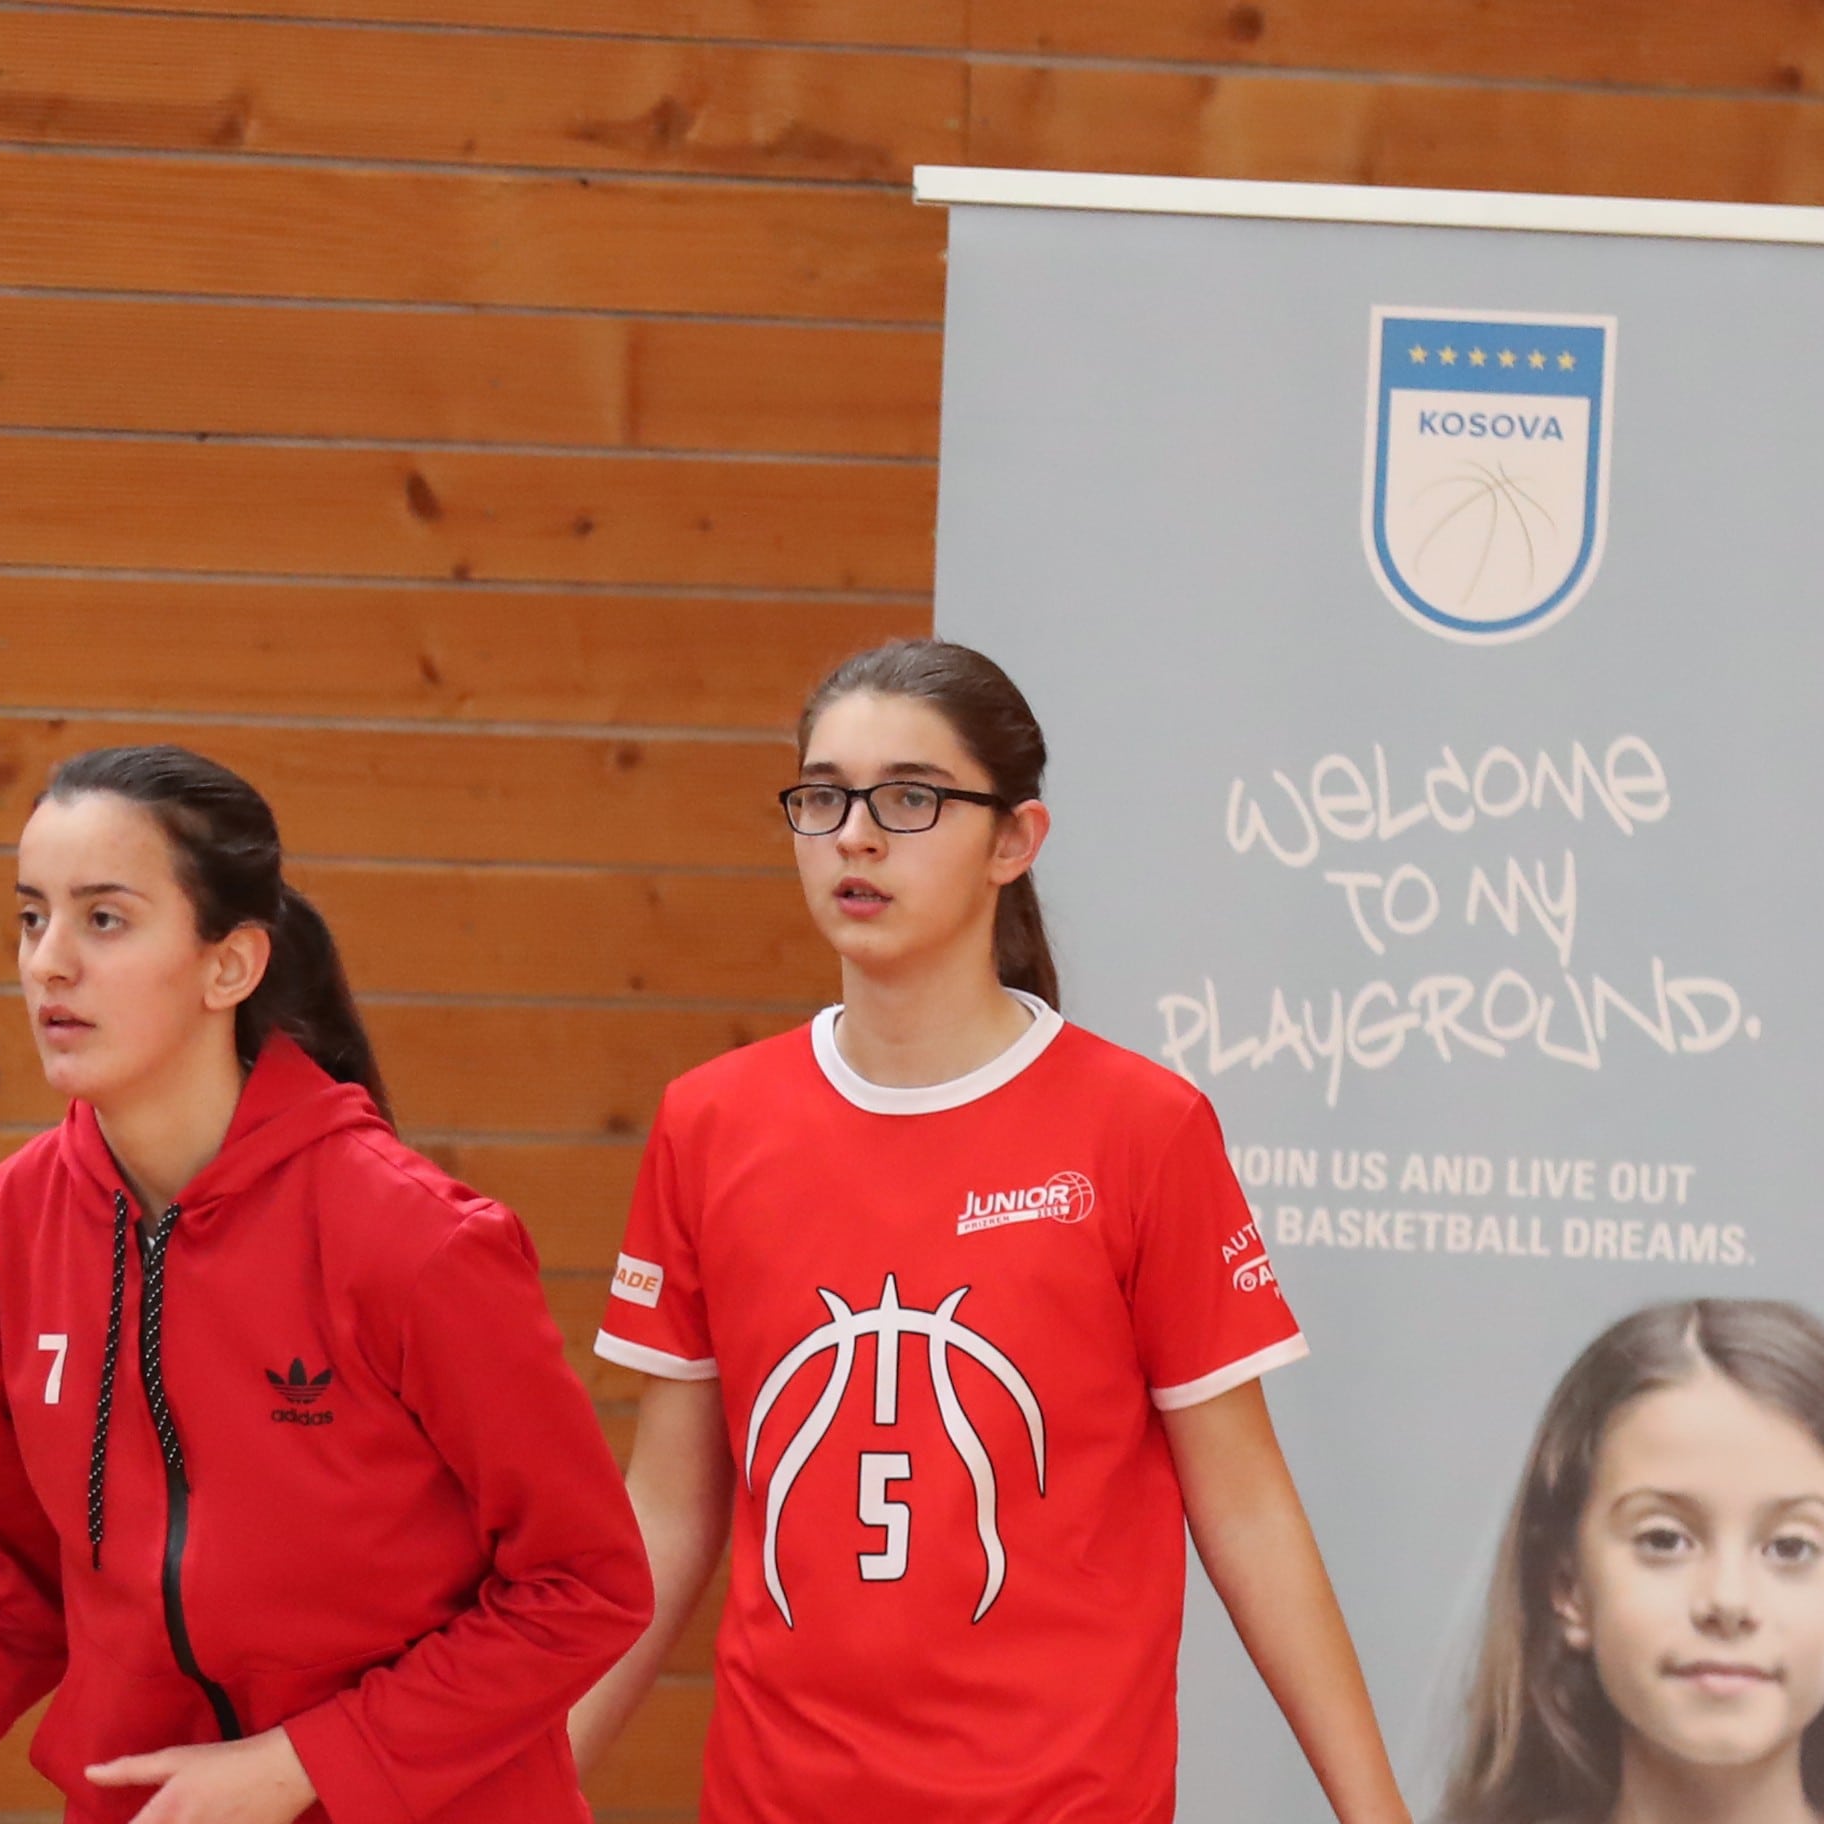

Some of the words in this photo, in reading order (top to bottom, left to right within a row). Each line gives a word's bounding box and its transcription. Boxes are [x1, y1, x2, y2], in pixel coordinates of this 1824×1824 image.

[1418, 410, 1564, 441] KOSOVA
[1324, 863, 1439, 955] TO
[958, 1184, 1070, 1221] JUNIOR
[1332, 1152, 1388, 1192] US
[1400, 1154, 1493, 1196] AND
[1506, 1159, 1596, 1200] LIVE
[1608, 1163, 1696, 1205] OUT
[1276, 1207, 1551, 1258] BASKETBALL
[1563, 1217, 1756, 1267] DREAMS.
[37, 1333, 69, 1405] 7
[858, 1451, 913, 1582] 5
